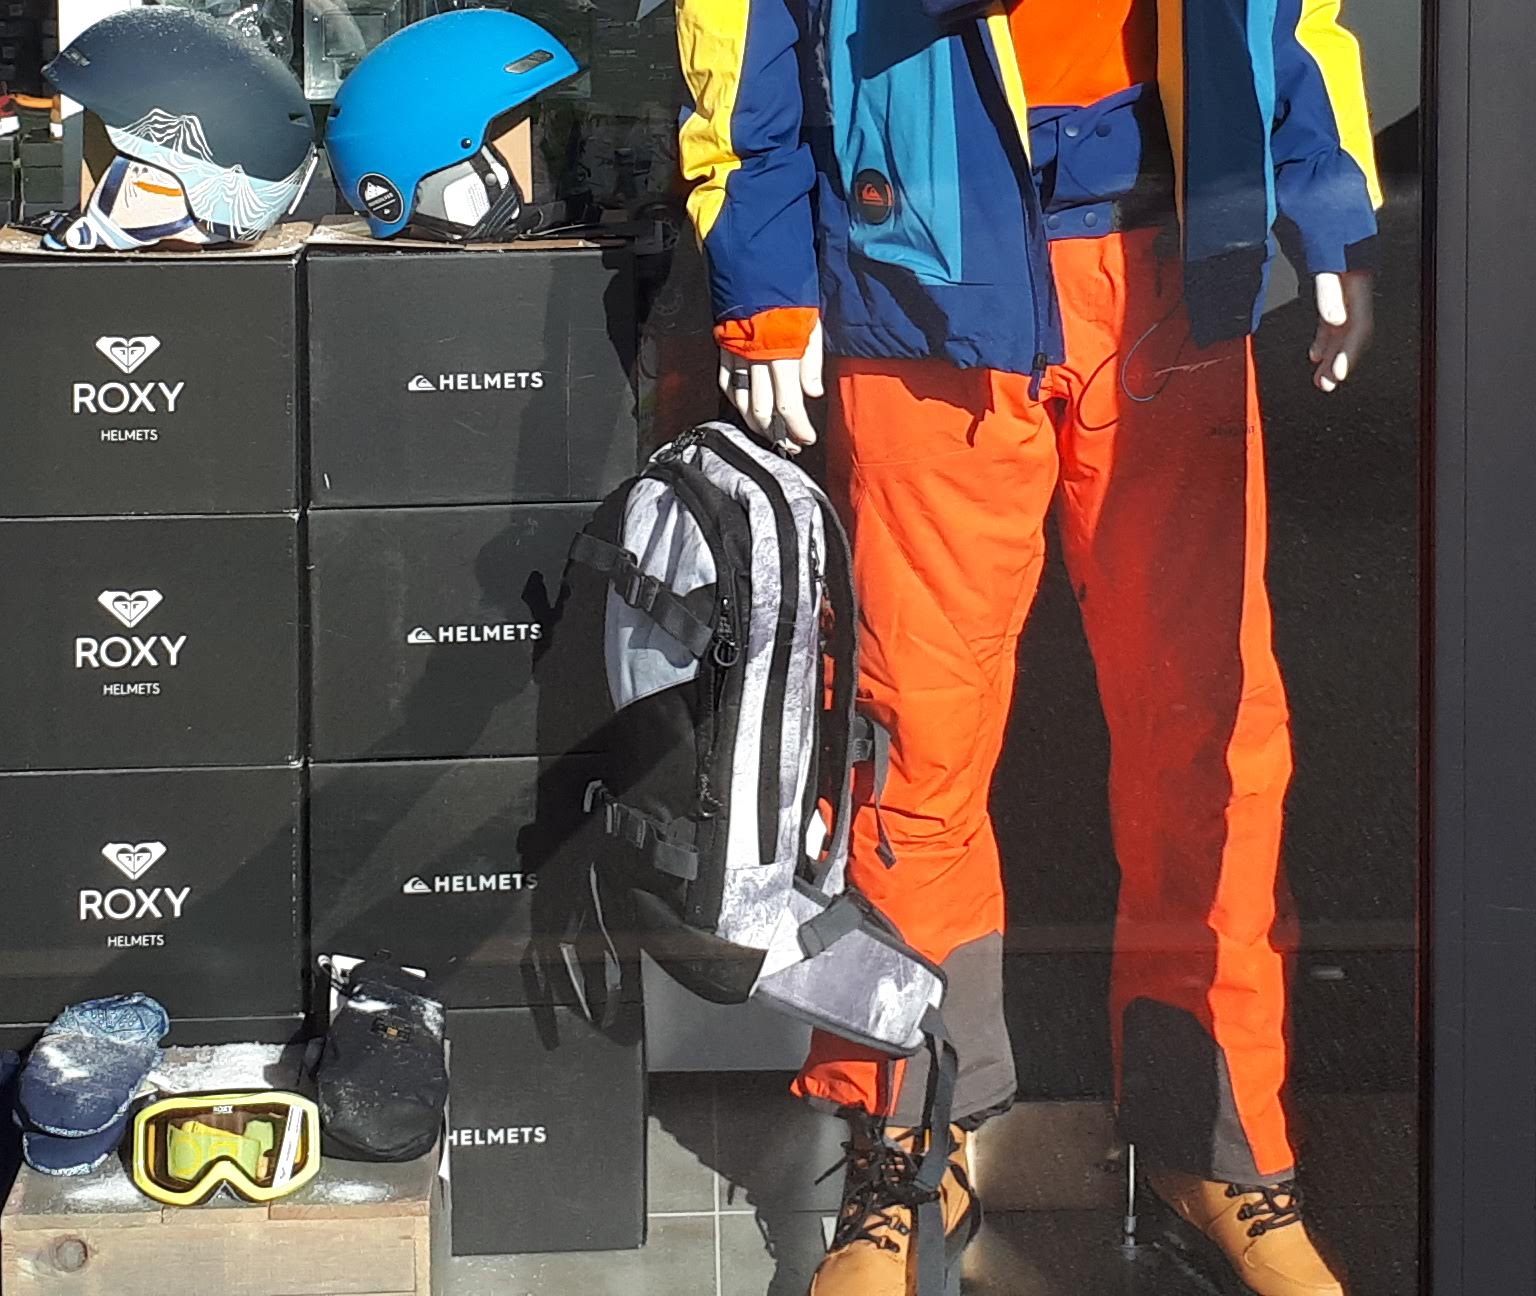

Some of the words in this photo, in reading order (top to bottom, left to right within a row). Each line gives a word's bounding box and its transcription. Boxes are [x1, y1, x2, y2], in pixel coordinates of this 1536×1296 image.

[439, 371, 544, 391] HELMETS
[73, 381, 185, 414] ROXY
[100, 428, 159, 442] HELMETS
[438, 623, 542, 644] HELMETS
[75, 635, 187, 668] ROXY
[102, 682, 161, 696] HELMETS
[434, 873, 538, 893] HELMETS
[79, 886, 191, 921] ROXY
[107, 934, 165, 948] HELMETS
[447, 1126, 547, 1146] HELMETS
